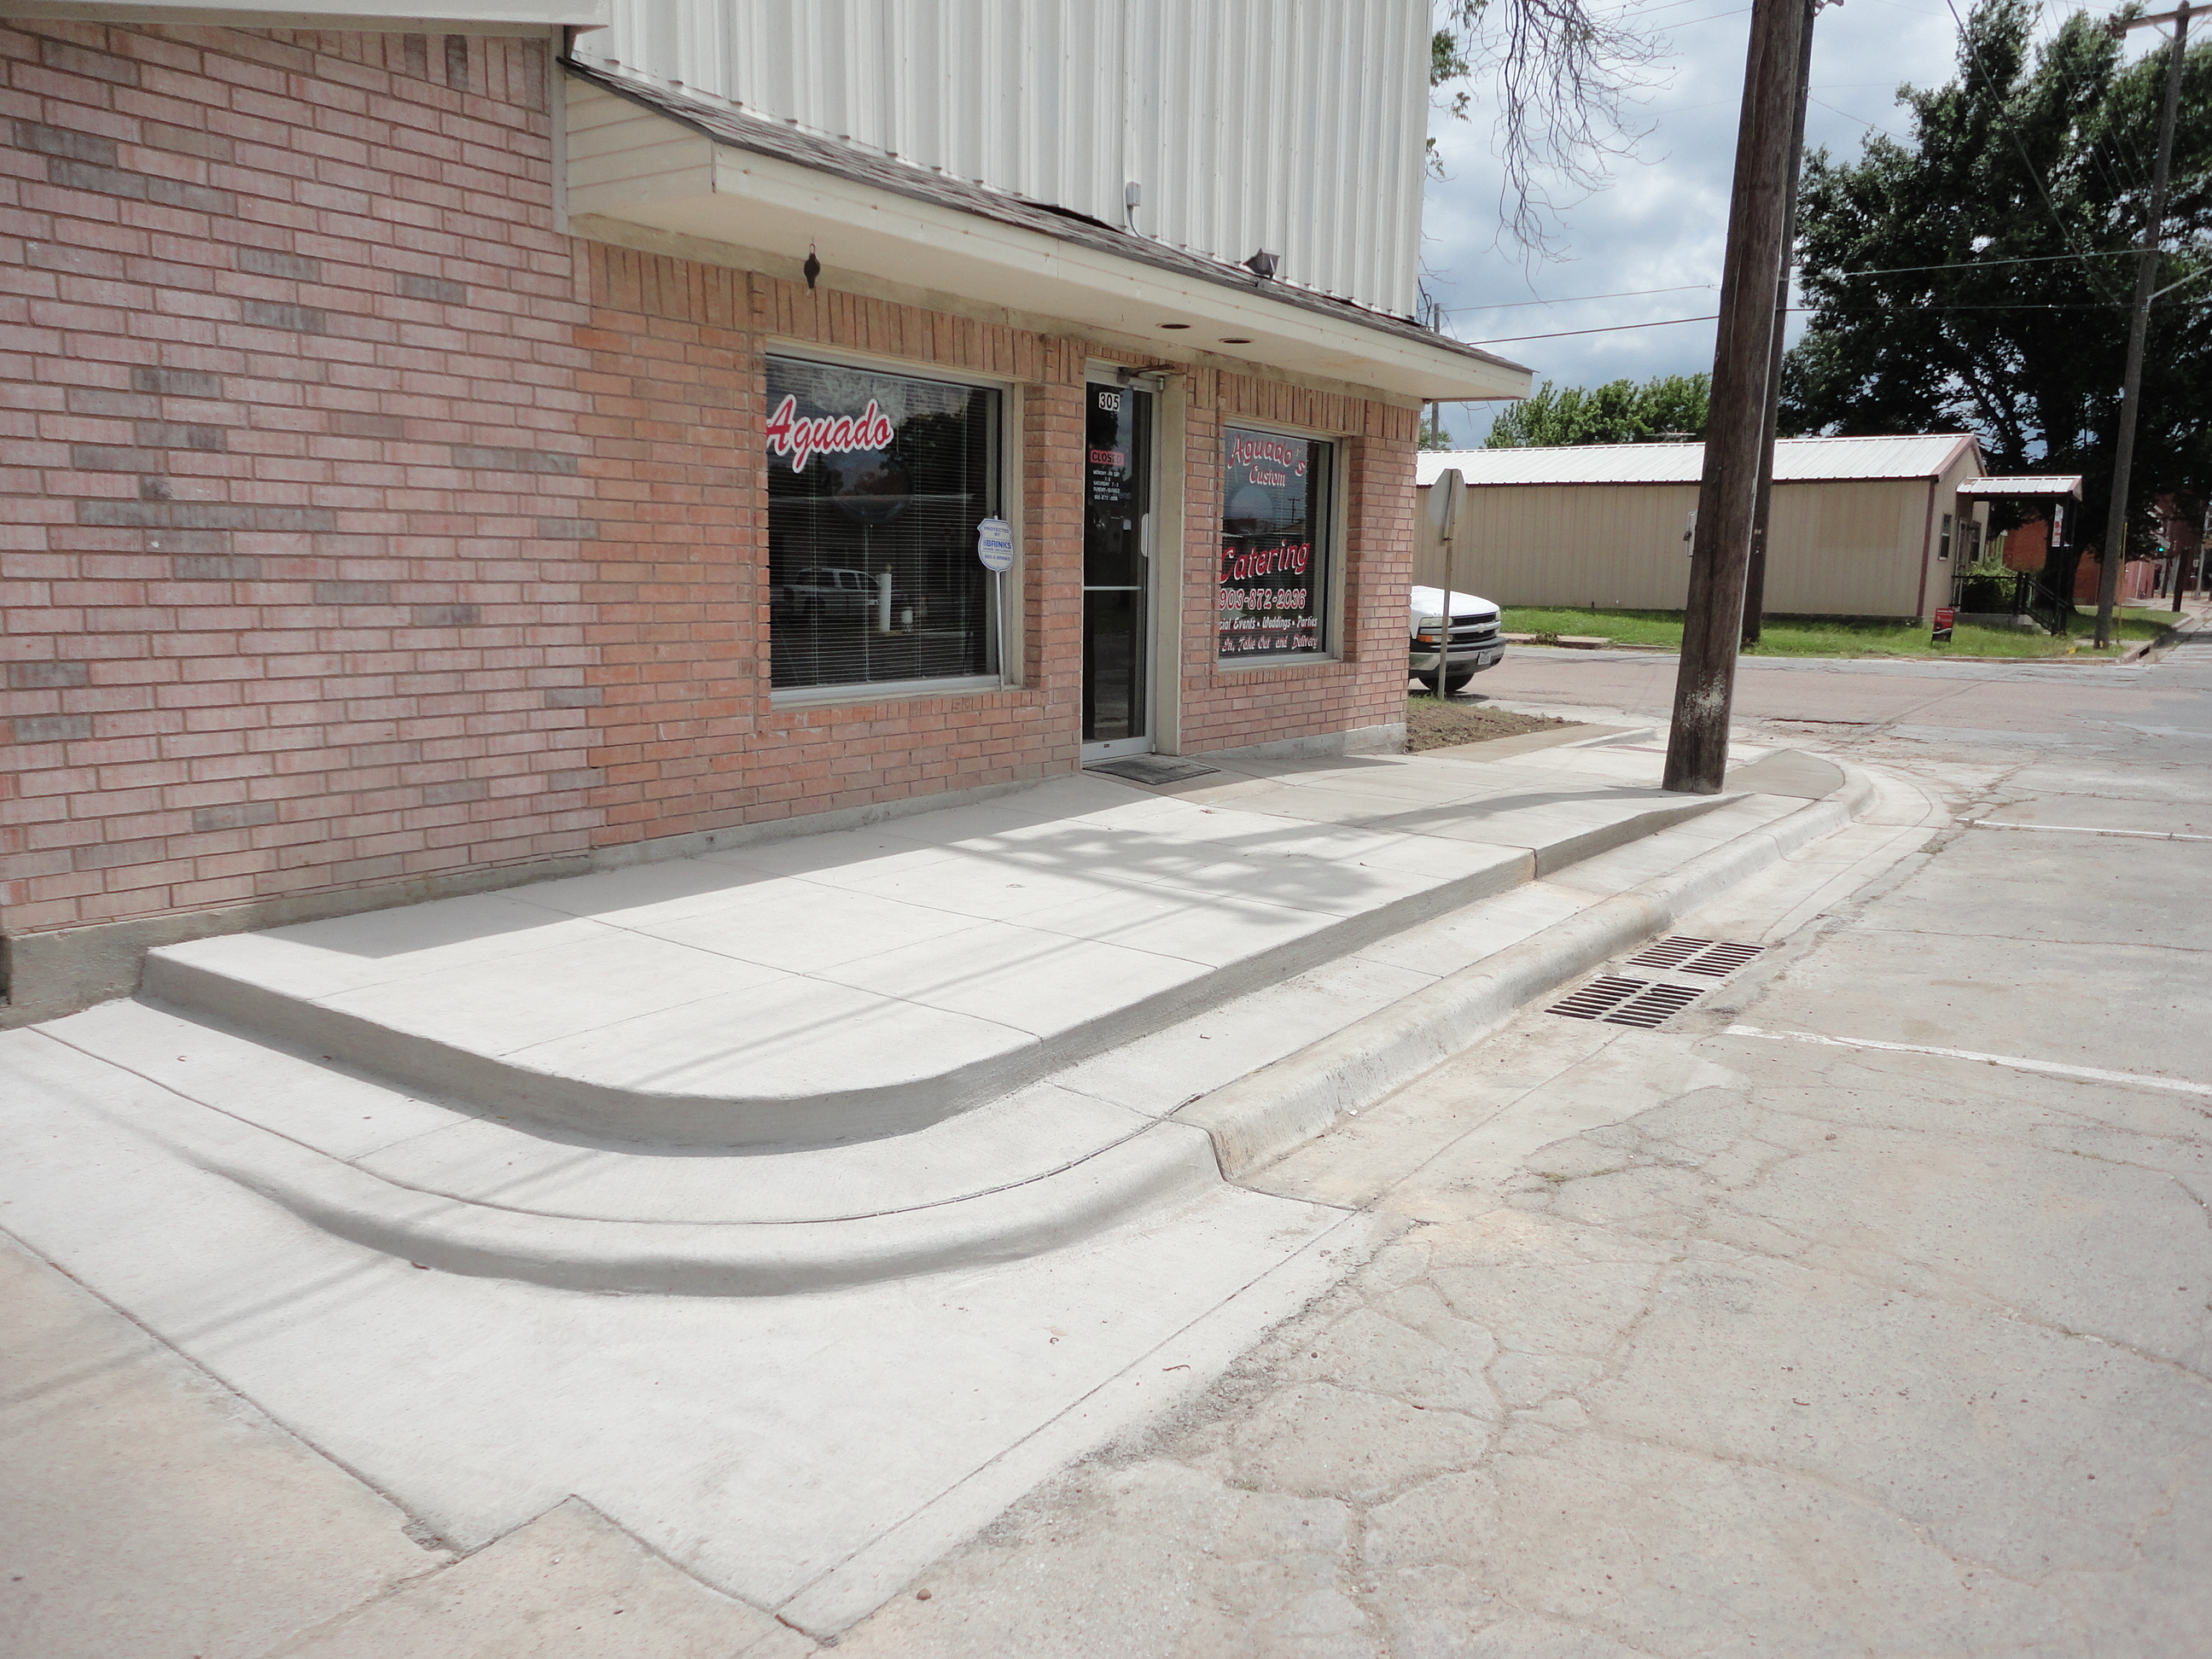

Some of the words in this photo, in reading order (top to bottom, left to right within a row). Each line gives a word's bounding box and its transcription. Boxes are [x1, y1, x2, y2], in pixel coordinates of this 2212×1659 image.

[1100, 393, 1119, 410] 305
[766, 394, 894, 474] Aguado
[1092, 451, 1121, 463] CLOSED
[1227, 434, 1307, 476] Aguado's
[1249, 464, 1286, 487] Custom
[987, 539, 1011, 550] BRINKS
[1220, 538, 1310, 585] Catering
[1220, 588, 1307, 610] 903-872-2036
[1233, 617, 1256, 630] Events
[1262, 616, 1291, 630] Weddings
[1297, 615, 1318, 628] Parties
[1237, 637, 1256, 652] Take
[1275, 635, 1289, 649] and
[1292, 634, 1318, 649] Delivery
